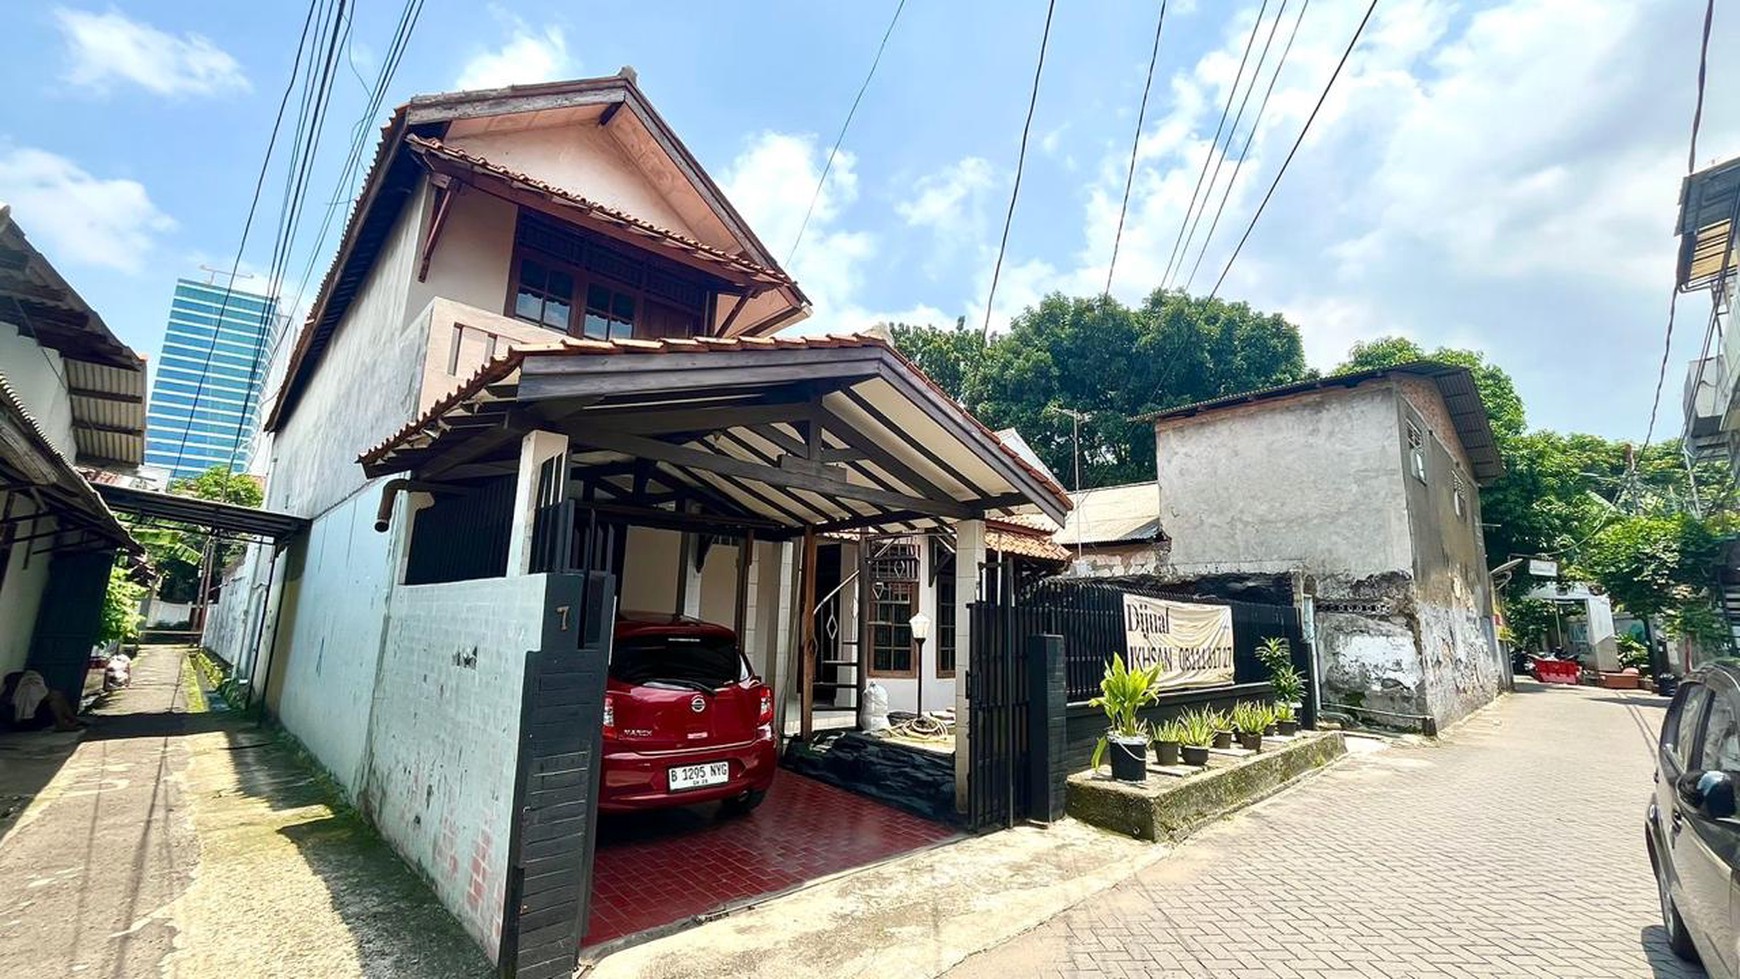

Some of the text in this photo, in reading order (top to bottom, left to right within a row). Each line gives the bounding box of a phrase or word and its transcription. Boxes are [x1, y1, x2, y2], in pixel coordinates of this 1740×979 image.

[556, 606, 570, 631] 7
[1126, 604, 1170, 640] Dijual
[671, 763, 727, 782] B 1295 NYG
